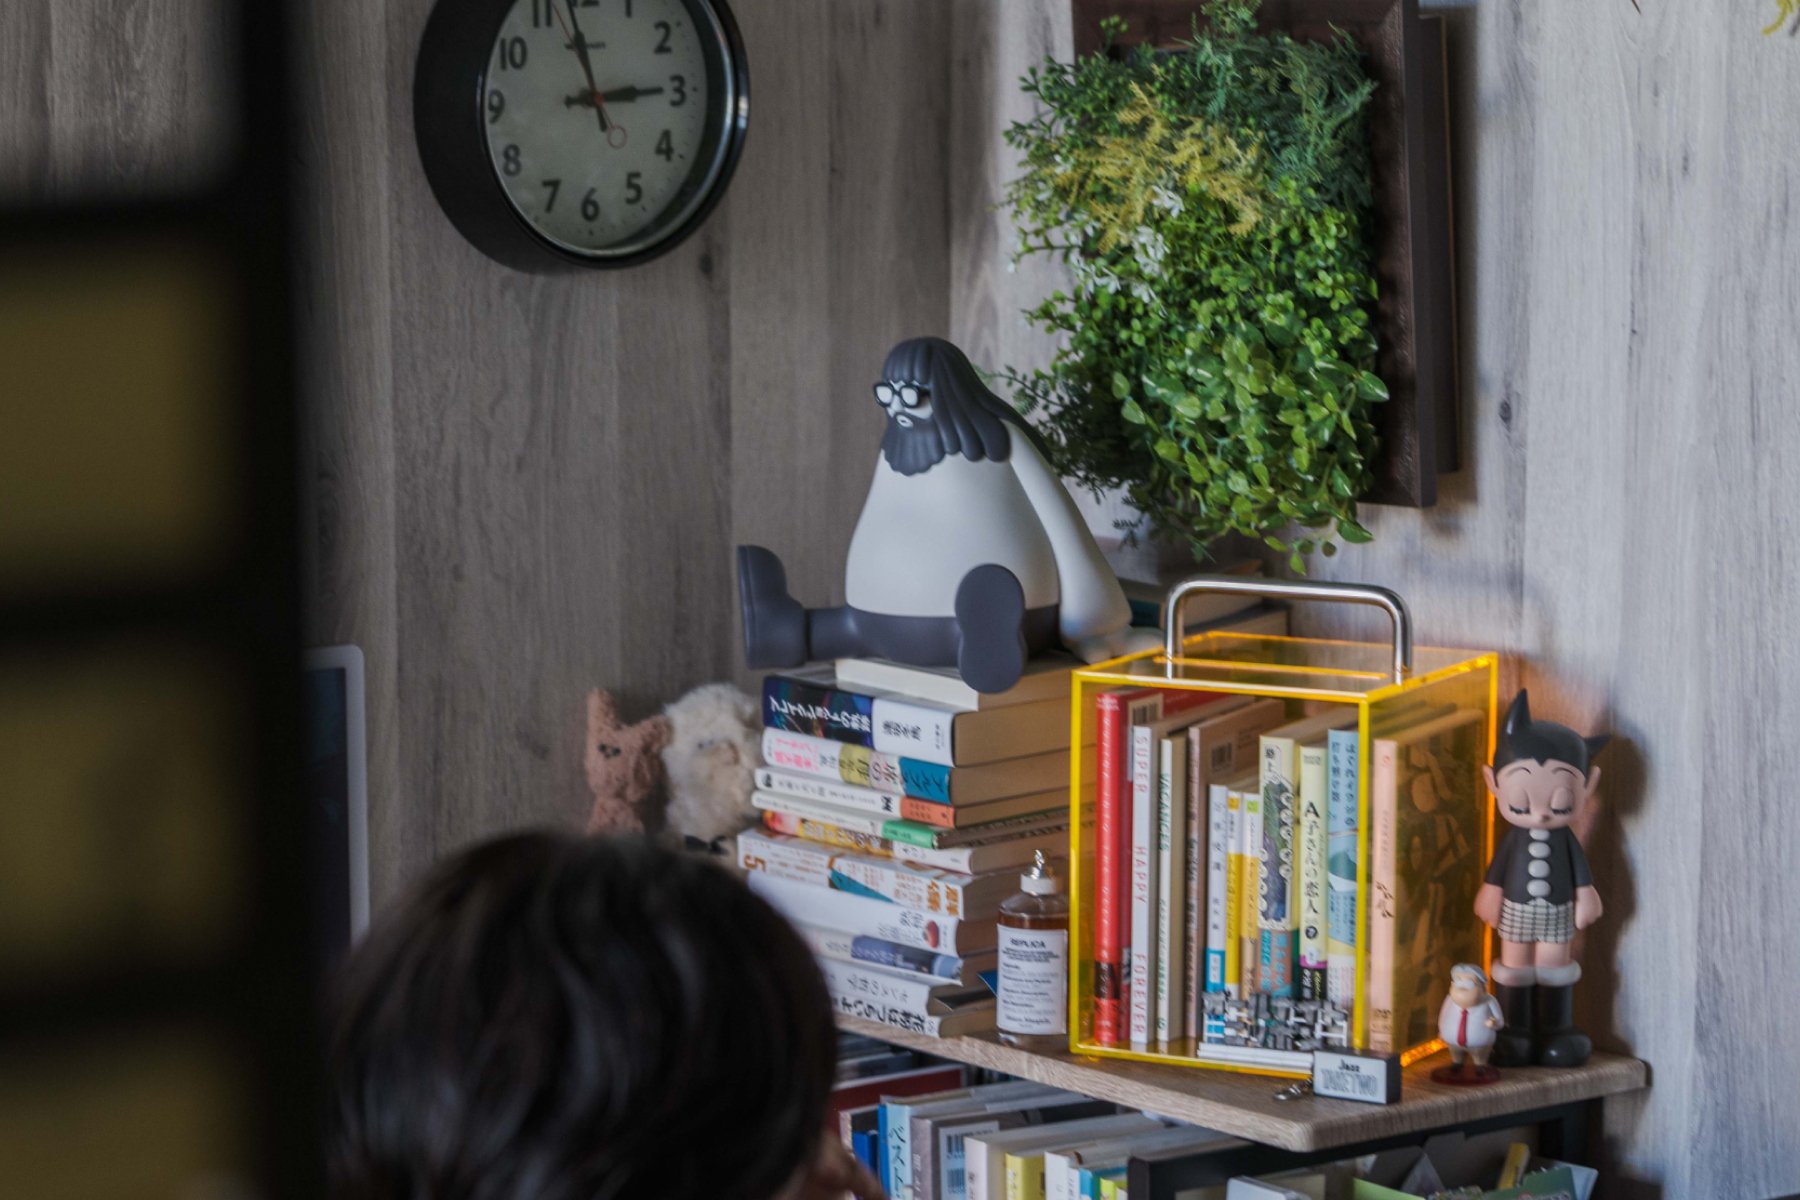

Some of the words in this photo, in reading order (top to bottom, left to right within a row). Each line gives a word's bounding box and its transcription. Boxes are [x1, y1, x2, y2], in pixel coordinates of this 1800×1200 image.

[500, 36, 527, 71] 10
[654, 21, 672, 54] 2
[488, 89, 505, 124] 9
[669, 75, 687, 107] 3
[502, 144, 522, 177] 8
[655, 129, 674, 162] 4
[541, 179, 562, 213] 7
[580, 187, 600, 222] 6
[625, 172, 643, 204] 5
[1135, 735, 1149, 793] SUPER
[1134, 845, 1148, 904] HAPPY
[1132, 953, 1146, 1034] FOREVER
[1339, 1058, 1360, 1073] Jazz
